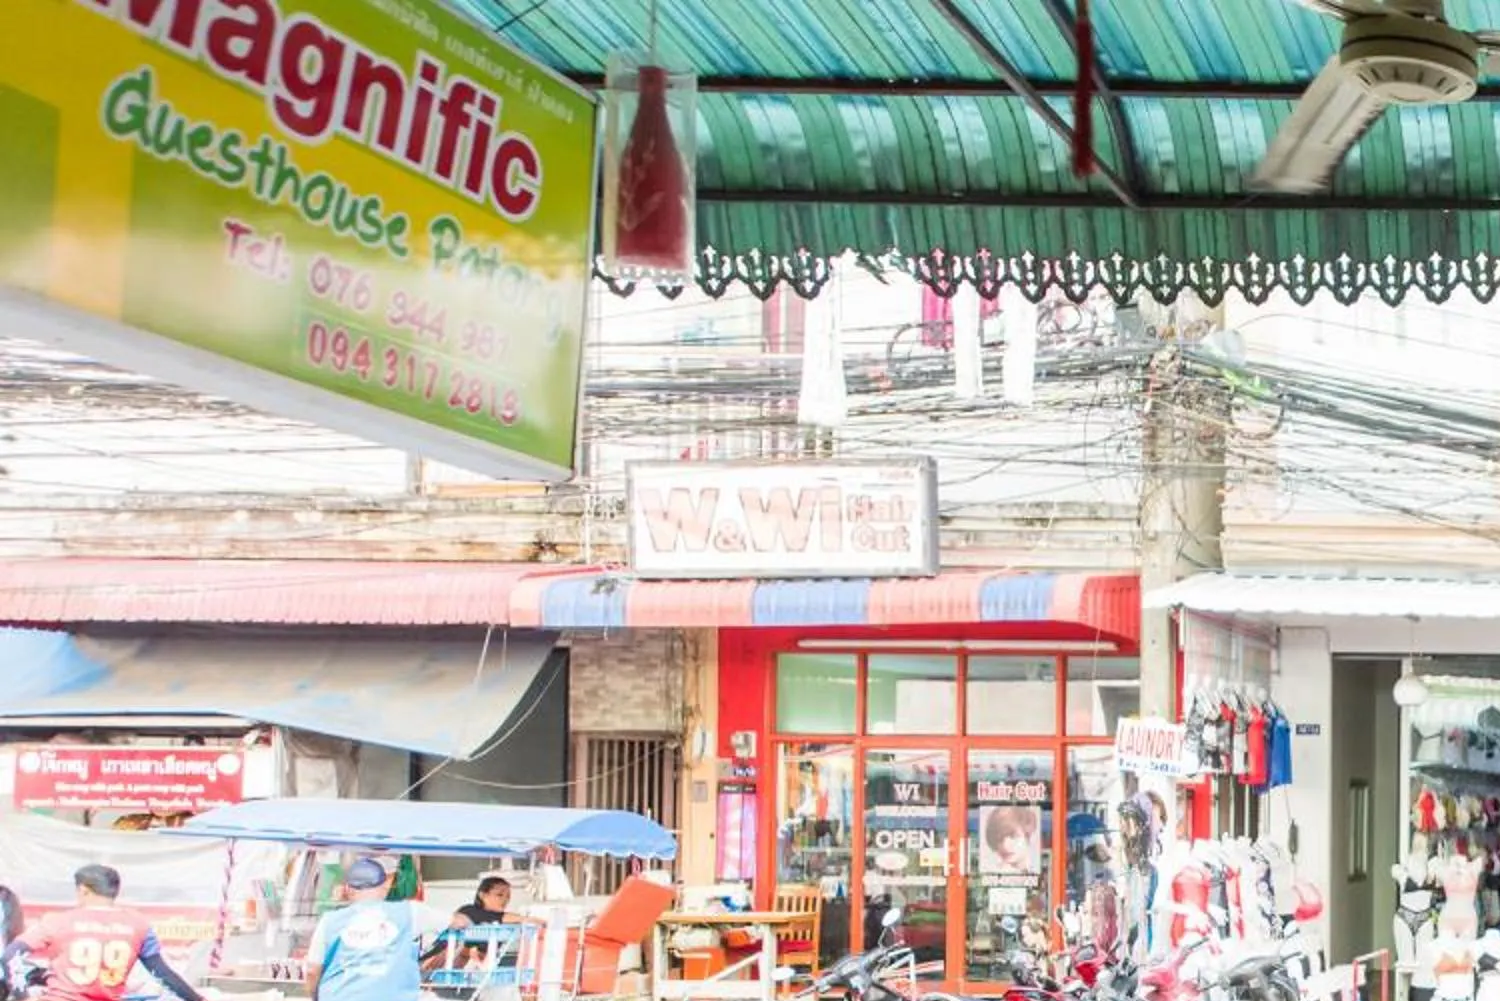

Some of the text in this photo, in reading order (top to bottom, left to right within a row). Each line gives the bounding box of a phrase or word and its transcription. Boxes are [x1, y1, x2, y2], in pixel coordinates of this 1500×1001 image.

[104, 68, 408, 257] Guesthouse
[875, 829, 935, 849] OPEN
[67, 938, 132, 988] 99
